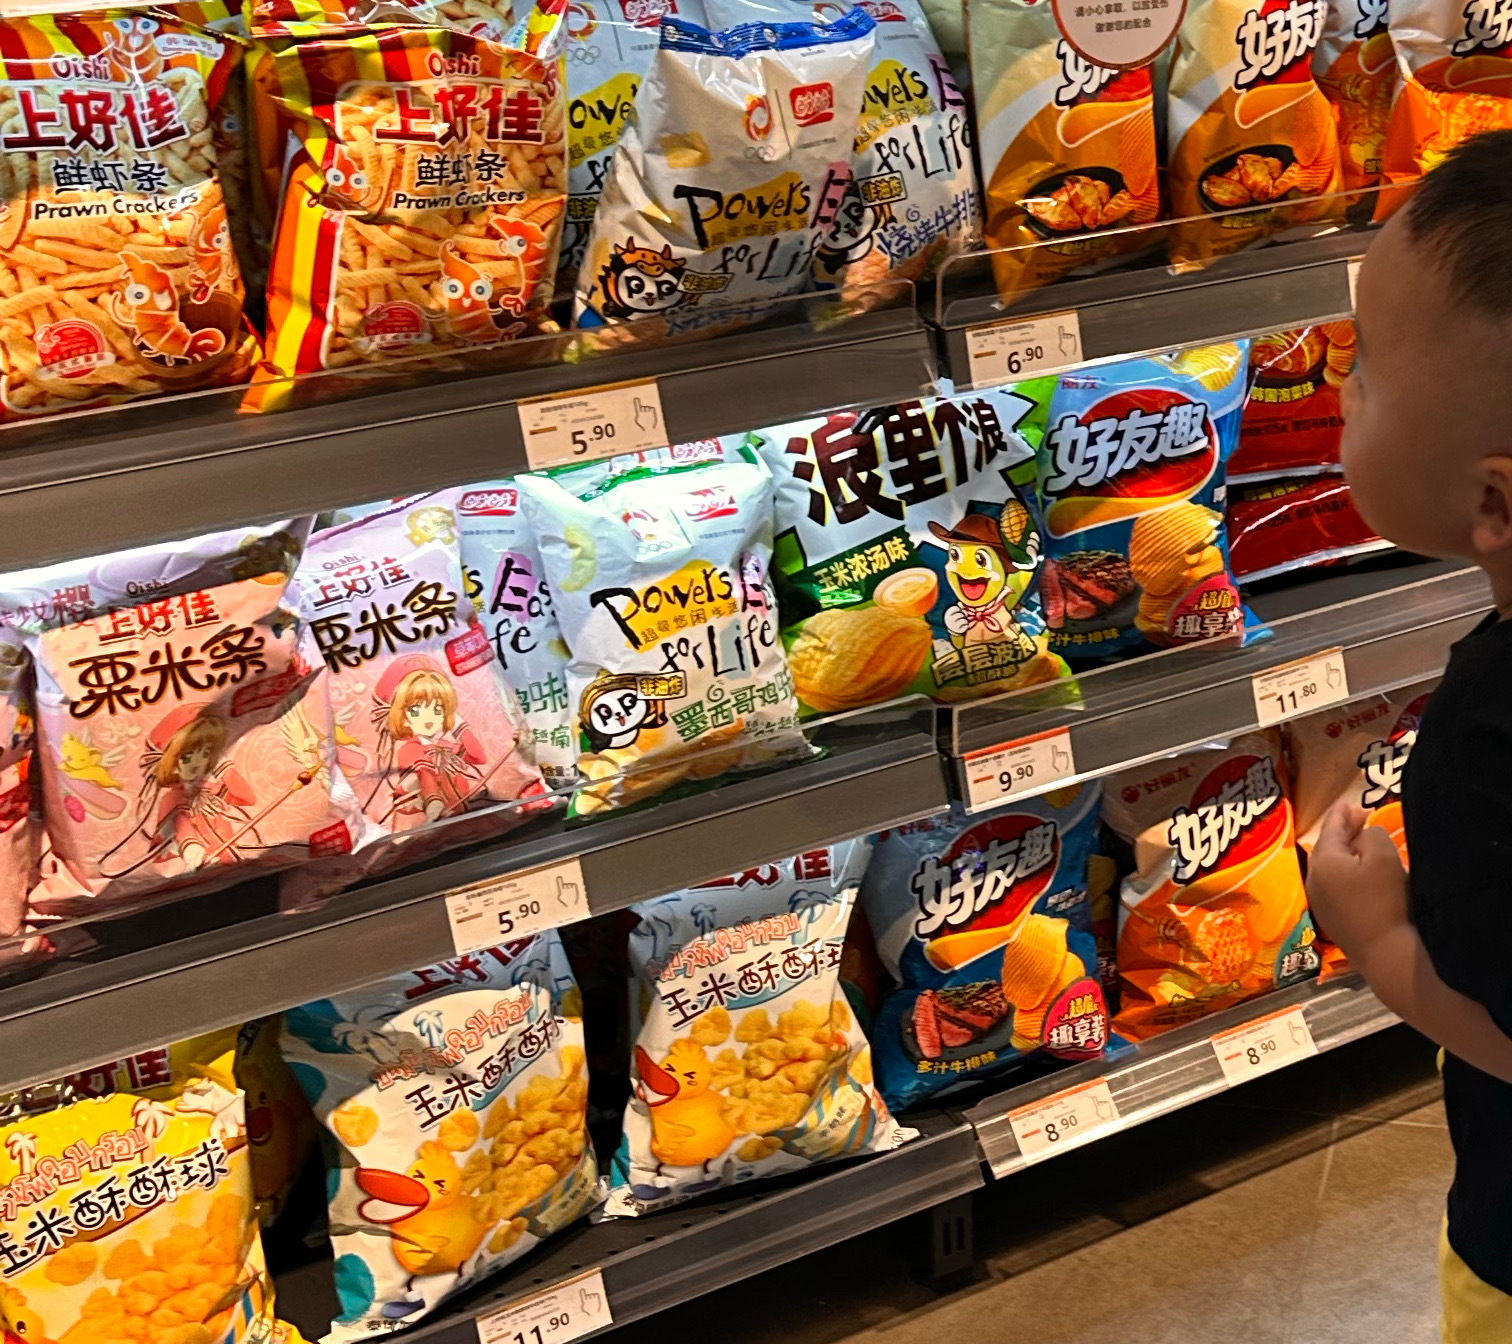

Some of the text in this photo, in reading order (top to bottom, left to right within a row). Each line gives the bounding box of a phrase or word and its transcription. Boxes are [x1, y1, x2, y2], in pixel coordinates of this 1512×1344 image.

[52, 56, 111, 82] Oishi
[427, 52, 482, 76] Oishi
[3, 86, 193, 154] 上好佳
[374, 85, 547, 147] 上好佳
[415, 149, 508, 189] 鲜虾条
[874, 134, 916, 174] for
[52, 161, 169, 196] 鲜虾条
[860, 174, 904, 204] 非油炸
[34, 189, 200, 222] Prawn Crackers
[393, 186, 525, 211] Prawn Crackers
[672, 179, 812, 251] Powers
[876, 188, 982, 268] 烧烤牛排
[711, 244, 761, 274] for
[1006, 344, 1044, 375] 6.90
[1250, 381, 1317, 404] 韩国泡菜味
[570, 422, 616, 456] 5.90
[1046, 402, 1210, 496] 好友趣
[784, 397, 1009, 526] 浪里个浪
[813, 534, 911, 595] 玉米浓汤味
[126, 576, 169, 598] Oishi
[312, 557, 411, 609] 上好佳
[99, 591, 222, 644] 上好佳
[590, 567, 735, 651] Powers
[640, 601, 740, 646] 超级悠闲生活
[659, 614, 777, 677] for Life
[932, 636, 1038, 688] 层层波浪
[639, 675, 684, 696] 非油炸
[1275, 682, 1319, 714] 11.80
[998, 764, 1035, 793] 9.90
[1143, 766, 1194, 795] 好丽友
[1169, 755, 1281, 885] 好友趣
[914, 820, 1058, 938] 好友趣
[496, 899, 541, 936] 5.90
[1048, 1014, 1107, 1050] 趣享装
[915, 1049, 998, 1075] 多汁牛排味
[1245, 1038, 1277, 1067] 8.90
[1044, 1114, 1080, 1143] 8.90
[1, 1137, 229, 1279] 玉米酥酥球
